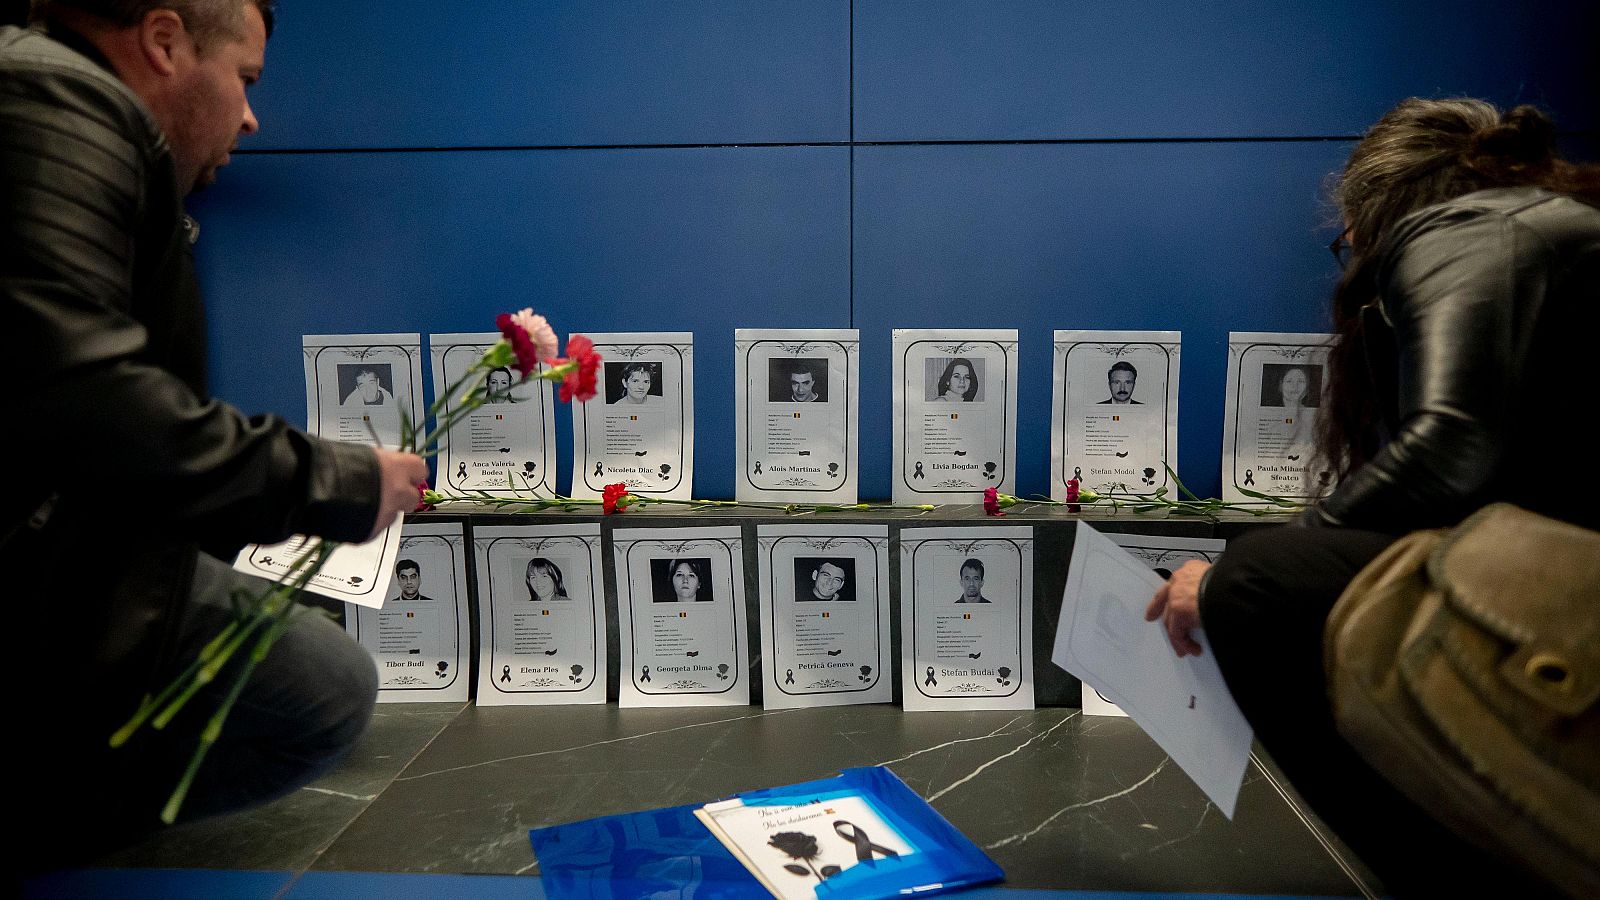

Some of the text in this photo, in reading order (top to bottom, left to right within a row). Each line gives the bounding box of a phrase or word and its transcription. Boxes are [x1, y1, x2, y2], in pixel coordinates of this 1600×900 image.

[491, 460, 516, 468] Valeria
[951, 463, 979, 471] Bogdan
[788, 465, 821, 473] Martinas
[1280, 465, 1311, 473] Mihaela
[520, 666, 541, 674] Elena
[656, 665, 691, 673] Georgeta
[970, 668, 995, 676] Budai
